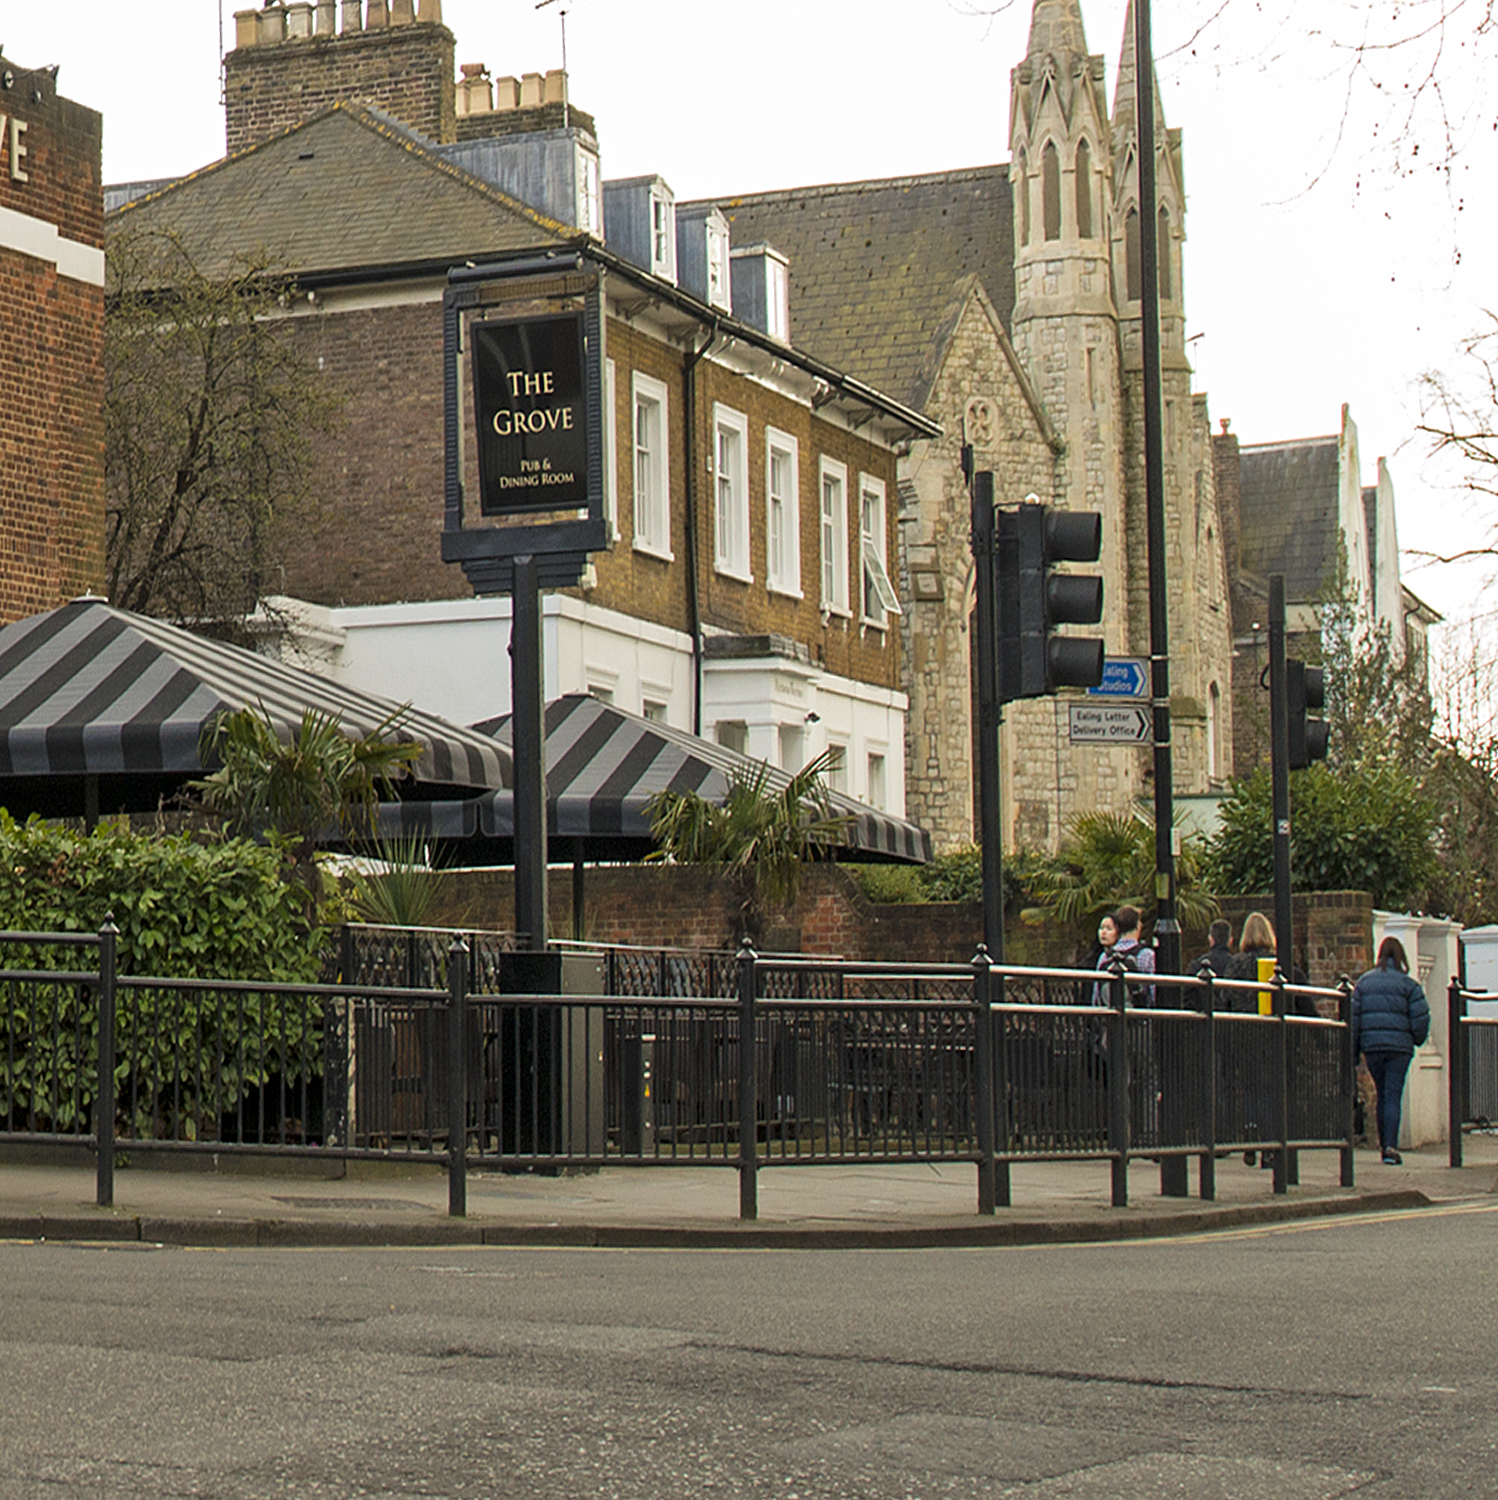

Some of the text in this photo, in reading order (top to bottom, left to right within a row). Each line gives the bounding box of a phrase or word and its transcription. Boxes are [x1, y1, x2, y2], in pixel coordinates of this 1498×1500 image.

[506, 371, 555, 397] THE
[493, 407, 574, 436] GROVE
[542, 457, 552, 471] &
[1104, 665, 1129, 680] aling
[1076, 711, 1131, 723] Ealing Letter
[1073, 724, 1136, 736] Delivery Office
